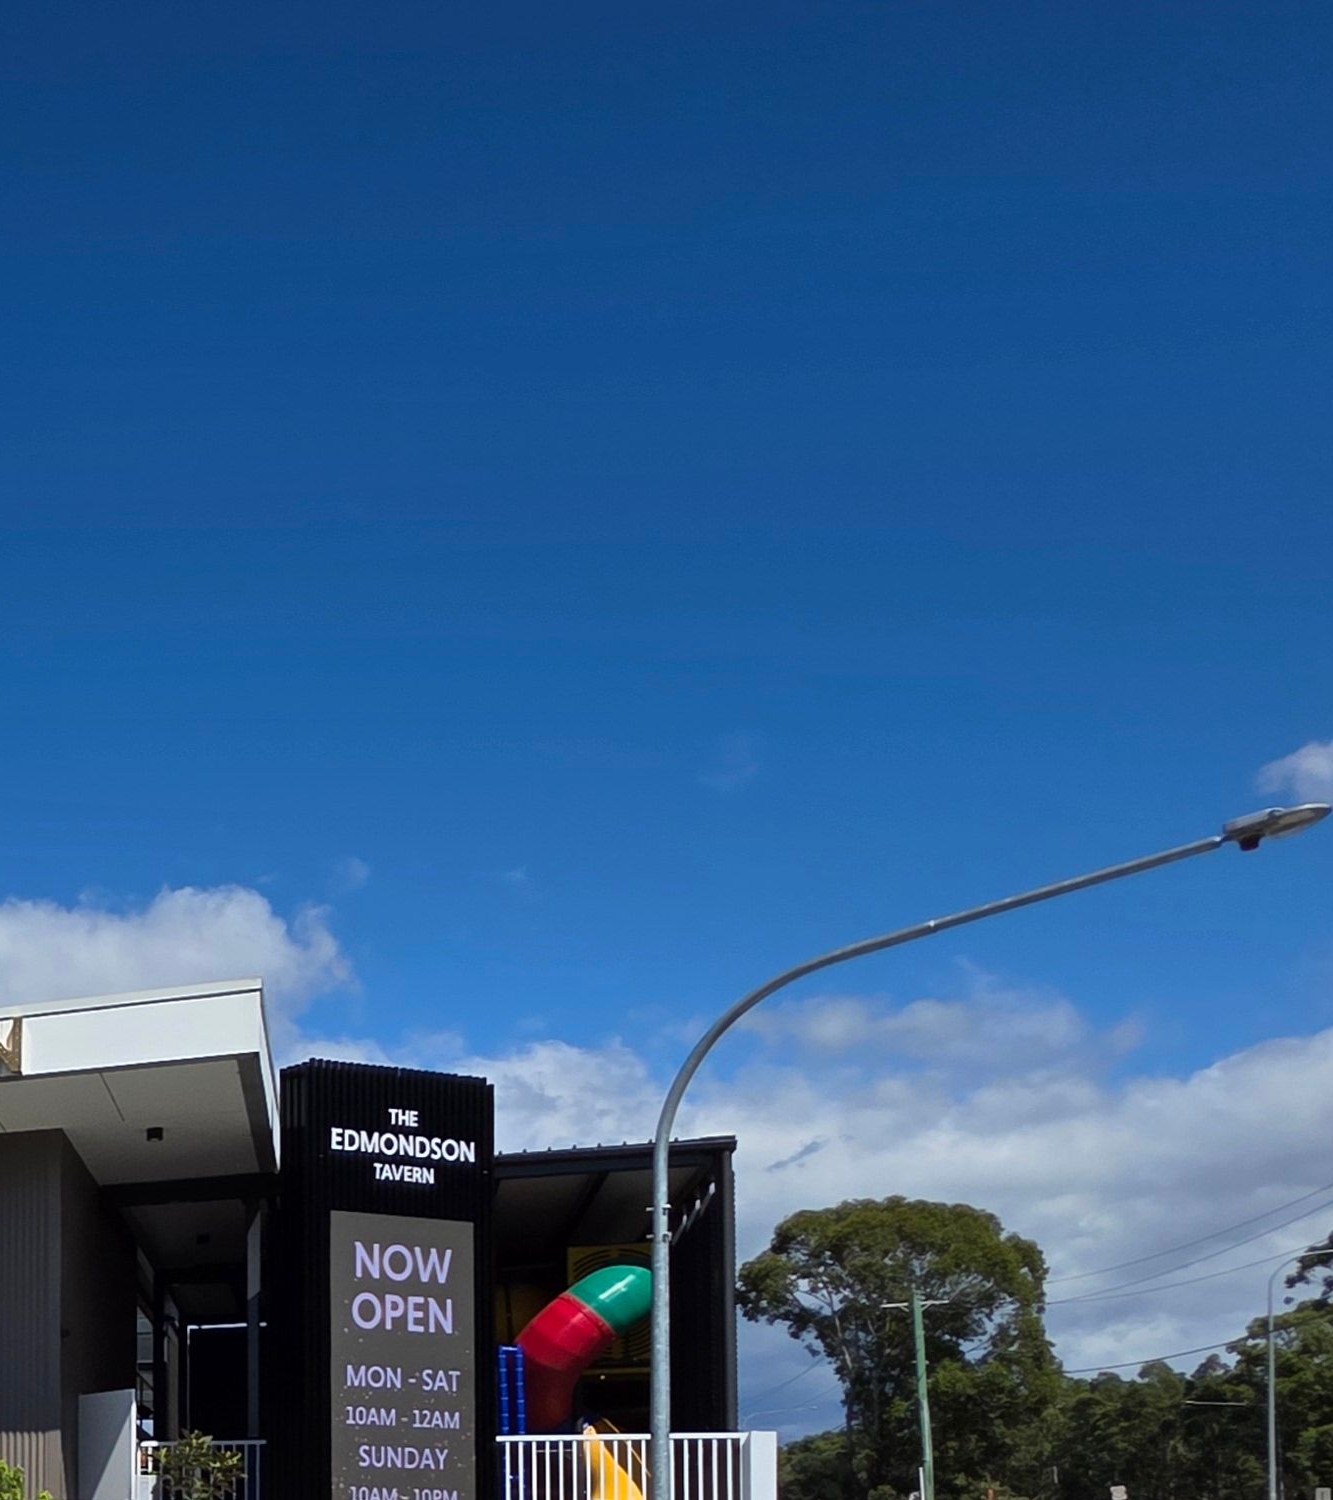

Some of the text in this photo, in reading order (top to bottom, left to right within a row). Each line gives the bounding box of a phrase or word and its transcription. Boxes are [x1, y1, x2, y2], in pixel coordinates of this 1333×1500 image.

[388, 1108, 419, 1127] THE
[330, 1126, 476, 1163] EDMONDSON
[373, 1162, 435, 1184] TAVERN
[354, 1241, 453, 1284] NOW
[351, 1291, 453, 1334] OPEN
[346, 1364, 402, 1389] MON
[422, 1369, 461, 1392] SAT
[345, 1406, 396, 1427] 10AM
[412, 1409, 460, 1429] 12AM
[358, 1445, 449, 1470] SUNDAY
